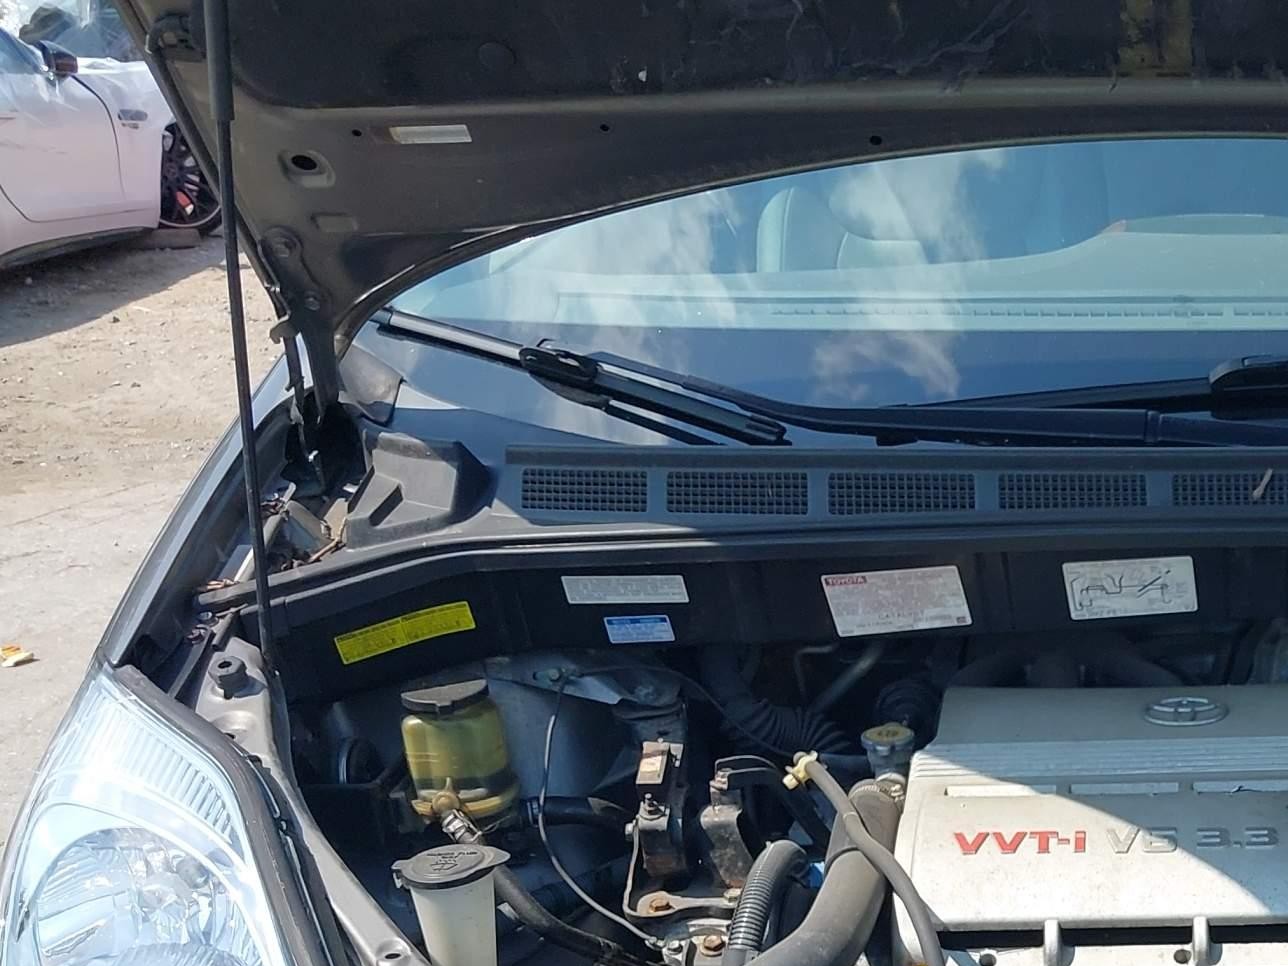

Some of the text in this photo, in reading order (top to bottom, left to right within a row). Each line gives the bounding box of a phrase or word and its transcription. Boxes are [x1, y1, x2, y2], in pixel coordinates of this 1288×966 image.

[827, 575, 867, 587] TOYOTA
[953, 826, 1281, 855] VVT-i V6 3.3
